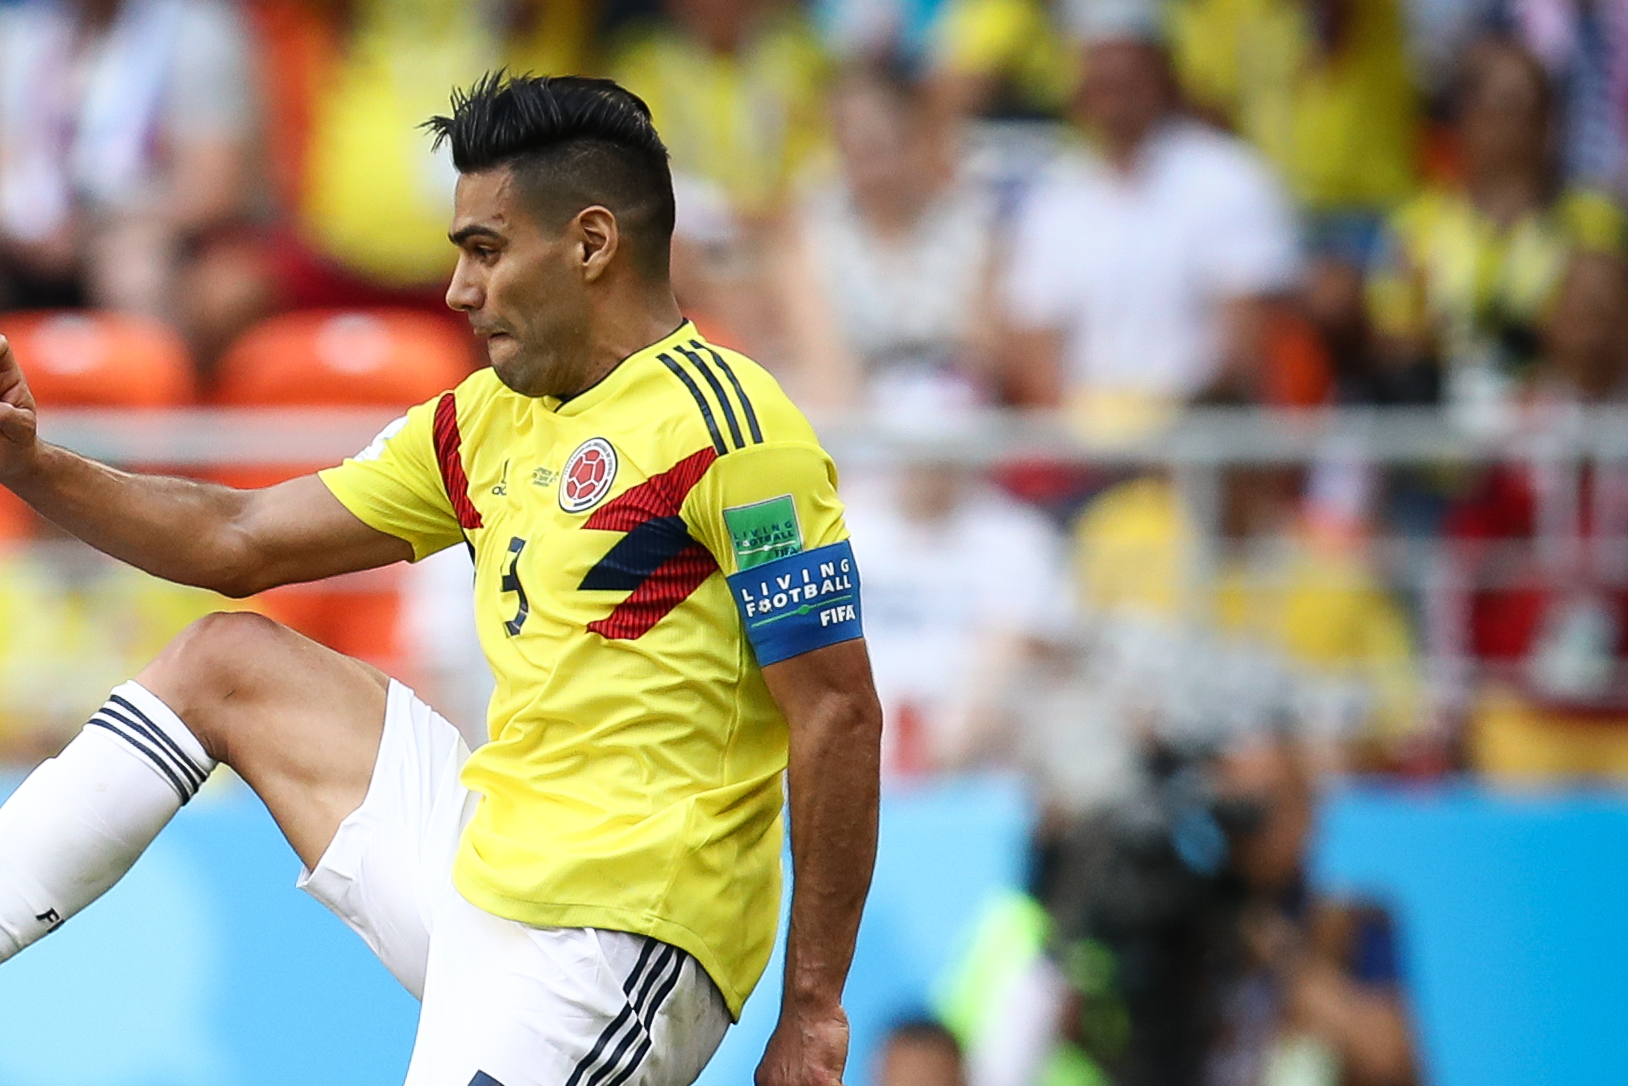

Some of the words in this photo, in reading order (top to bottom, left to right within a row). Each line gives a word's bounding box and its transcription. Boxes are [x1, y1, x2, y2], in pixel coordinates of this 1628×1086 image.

[741, 558, 849, 602] LIVING
[746, 575, 852, 617] FOOTBALL
[820, 604, 856, 627] FIFA
